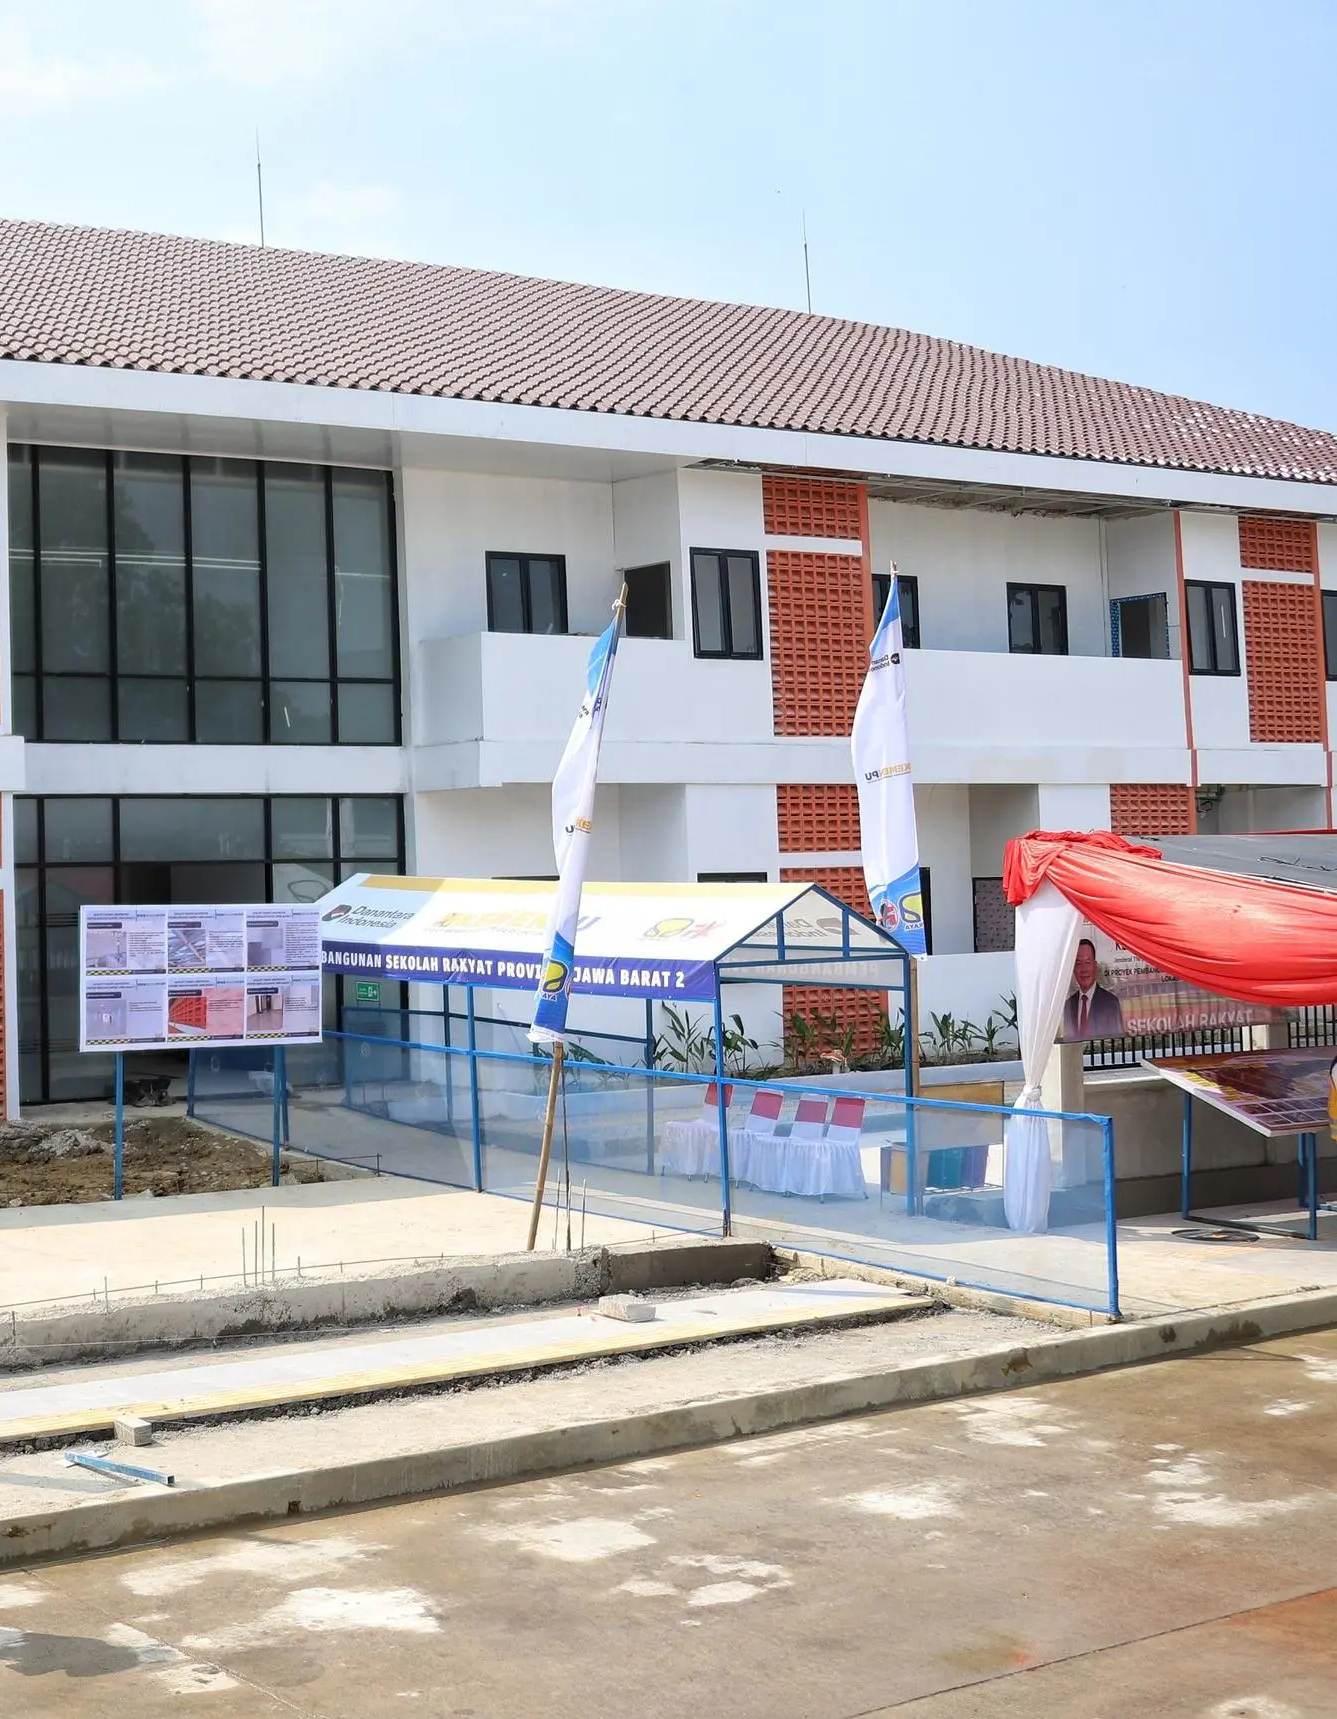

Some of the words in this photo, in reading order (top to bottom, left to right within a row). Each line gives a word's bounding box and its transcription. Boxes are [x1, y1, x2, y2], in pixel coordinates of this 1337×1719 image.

[338, 914, 397, 929] Indonesia
[352, 905, 415, 920] Danantara
[386, 955, 438, 972] SEKOLAH
[443, 957, 493, 976] RAKYAT
[573, 966, 615, 985] JAWA
[620, 969, 670, 988] BARAT
[675, 971, 685, 988] 2
[1126, 1014, 1195, 1037] SEKOLAH
[1199, 1009, 1253, 1028] RAKYAT
